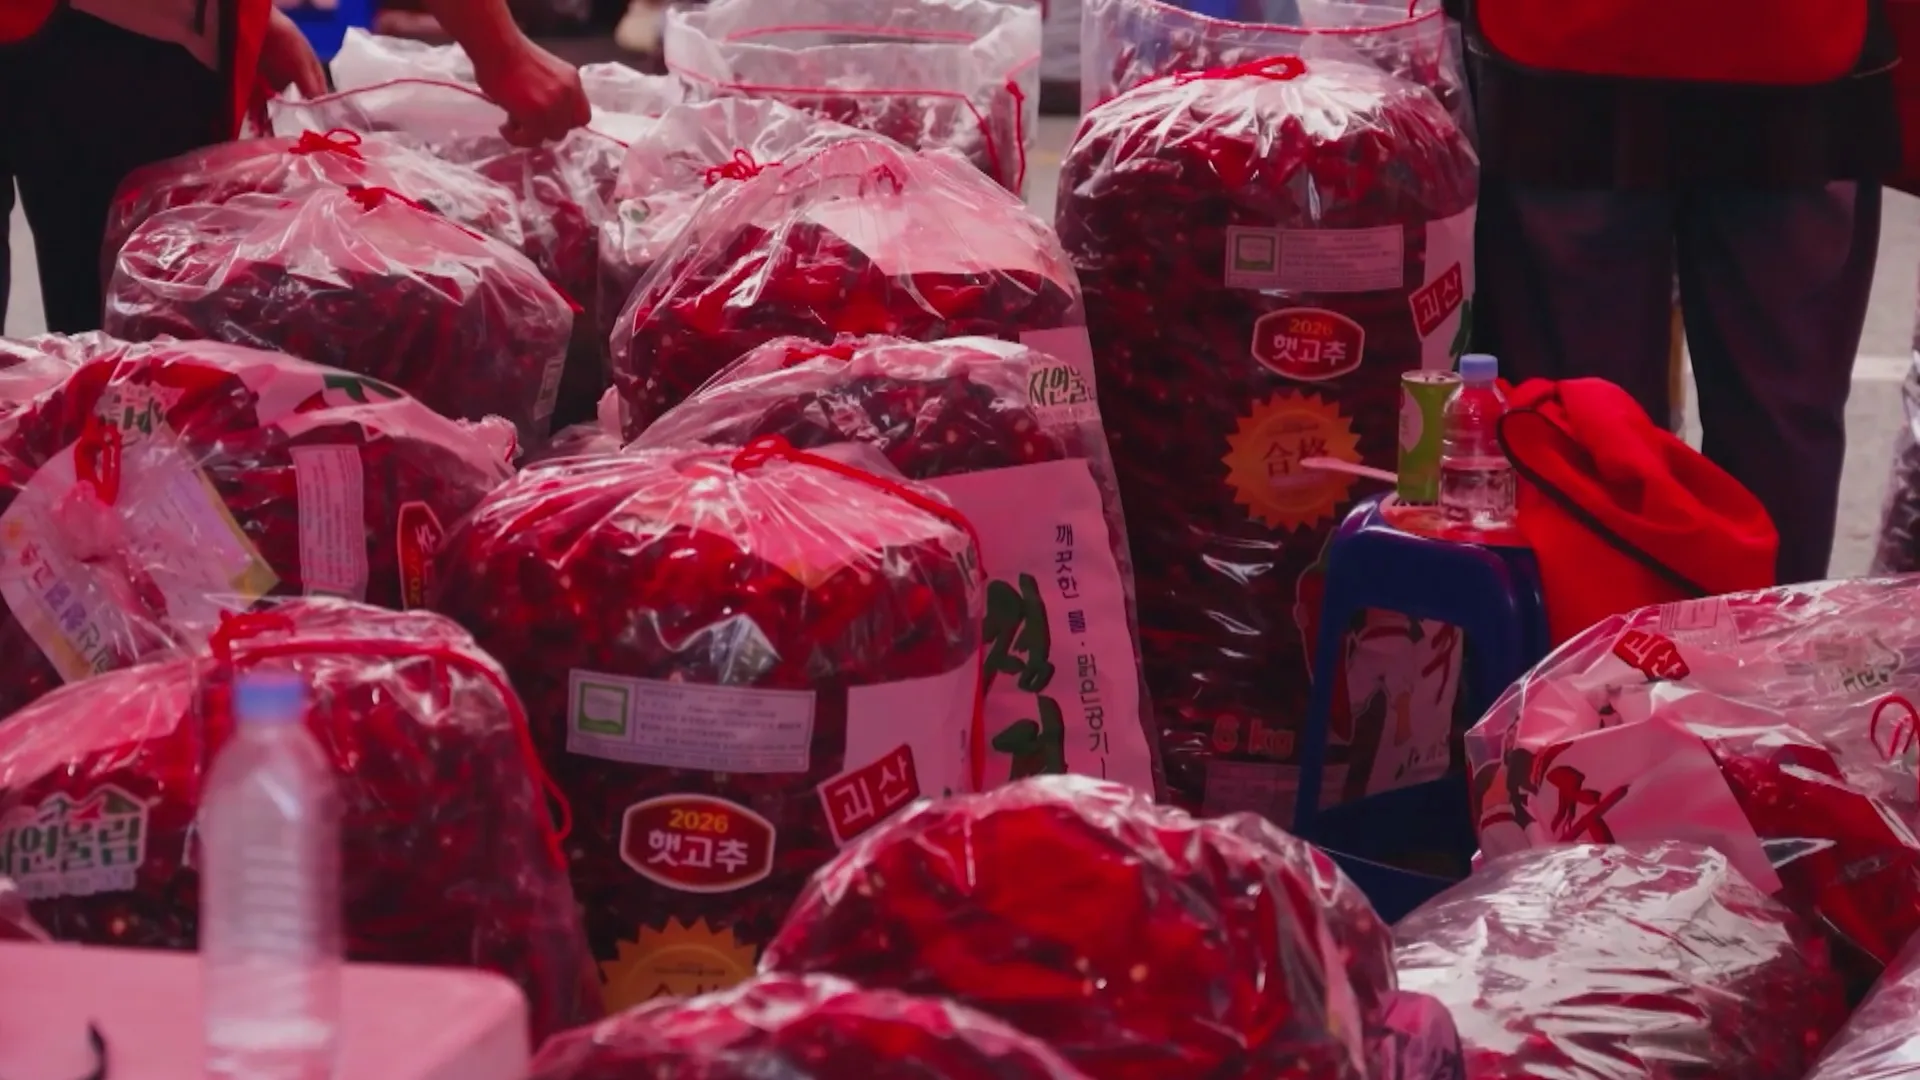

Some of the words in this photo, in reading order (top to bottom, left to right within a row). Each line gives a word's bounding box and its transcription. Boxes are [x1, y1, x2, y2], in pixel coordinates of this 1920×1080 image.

[1419, 269, 1460, 325] 괴산
[1289, 318, 1333, 336] 2026
[1272, 334, 1347, 366] 햇고추
[1055, 524, 1079, 599] 깨끗한
[1068, 610, 1086, 634] 물
[834, 754, 910, 825] 괴산
[668, 808, 729, 834] 2026
[647, 830, 749, 874] 햇고추
